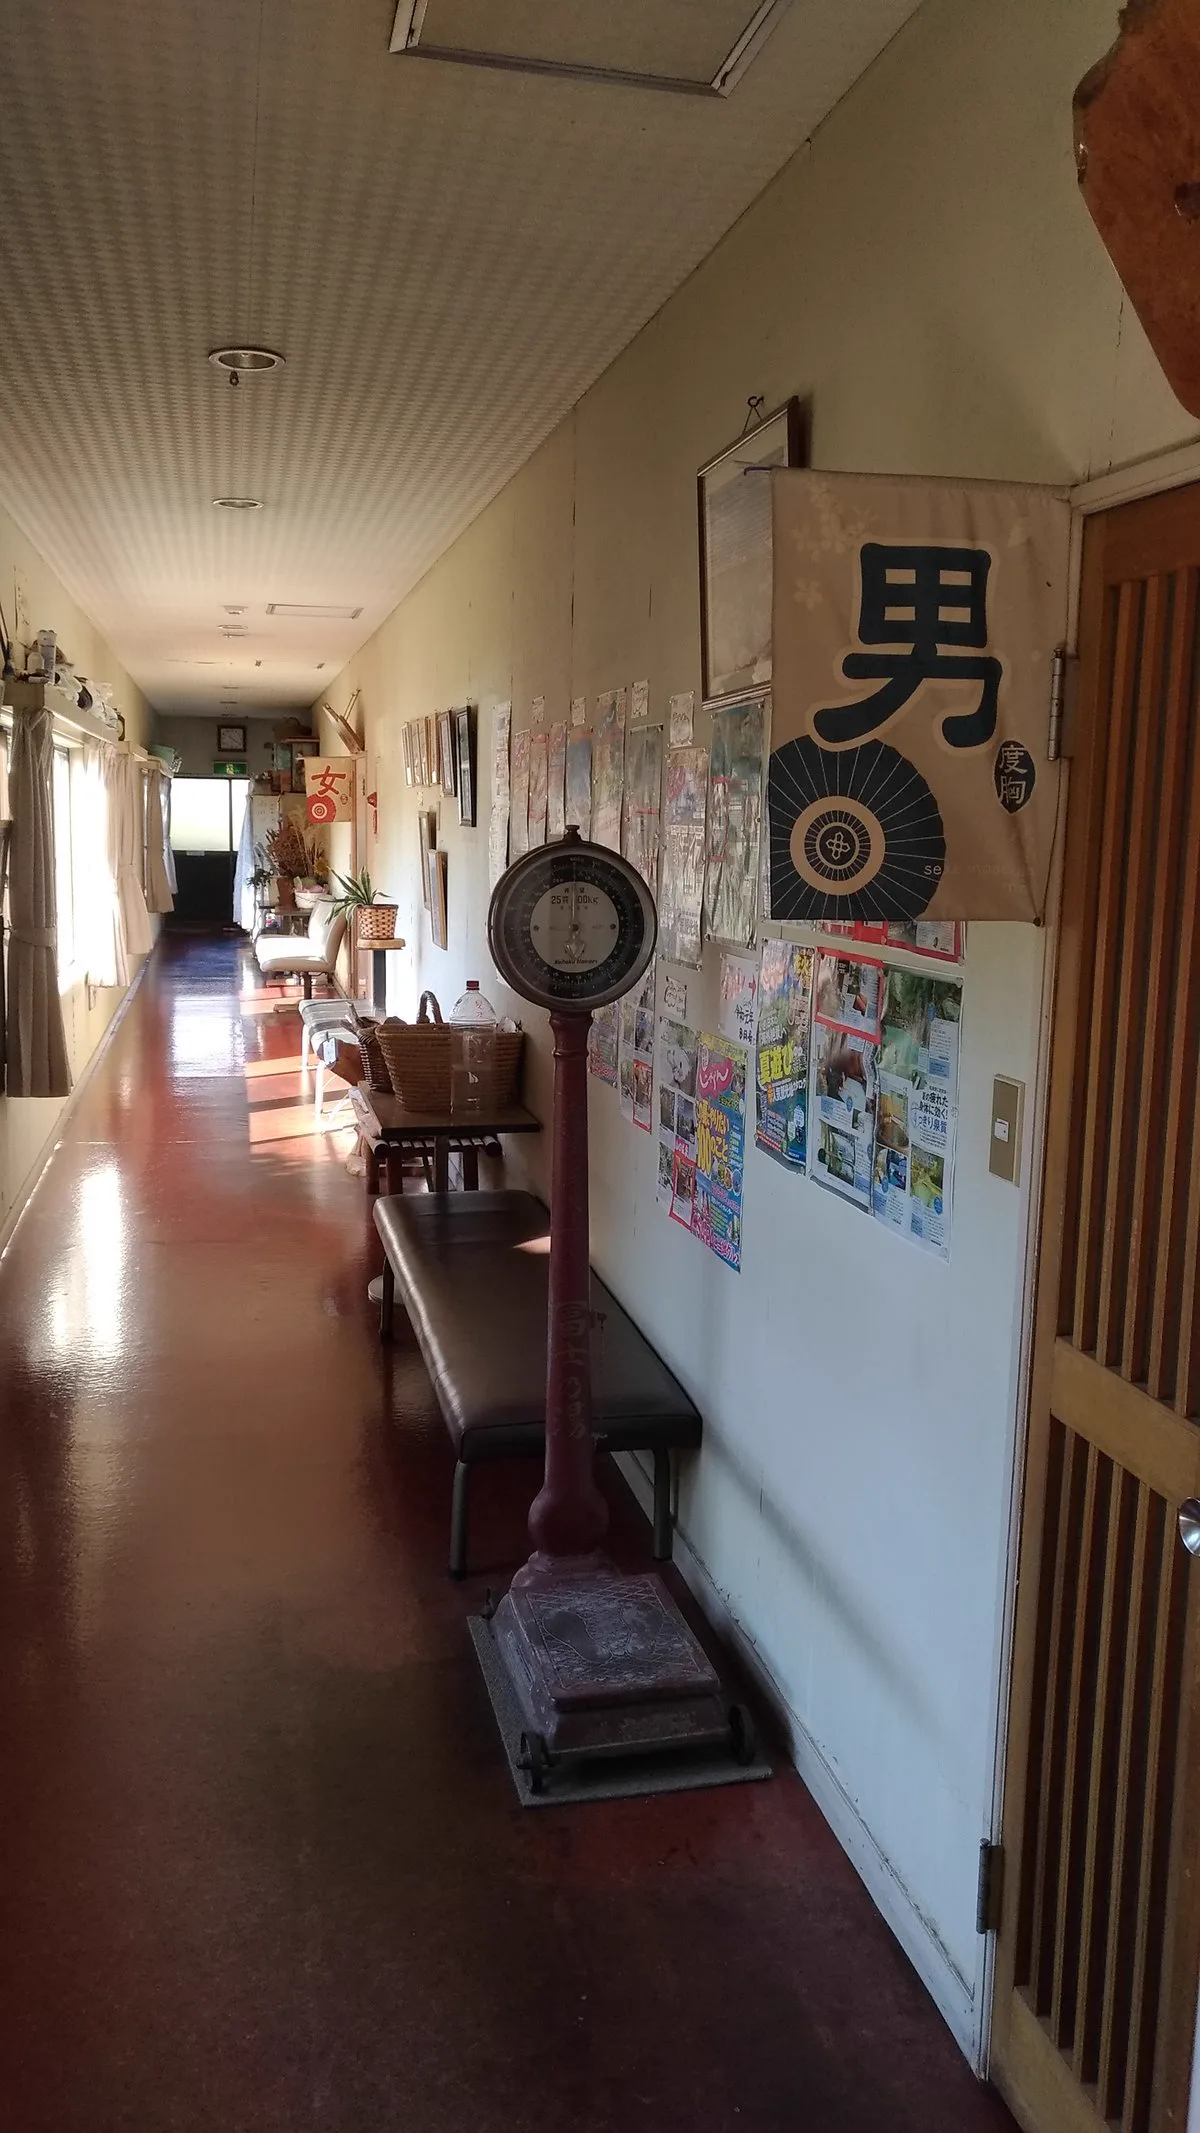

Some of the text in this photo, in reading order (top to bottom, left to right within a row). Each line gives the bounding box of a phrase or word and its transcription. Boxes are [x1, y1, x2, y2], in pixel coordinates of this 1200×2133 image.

[813, 542, 1003, 748] 男
[311, 765, 346, 796] 女
[999, 744, 1028, 804] 度胸
[759, 1040, 793, 1084] 夏遊び
